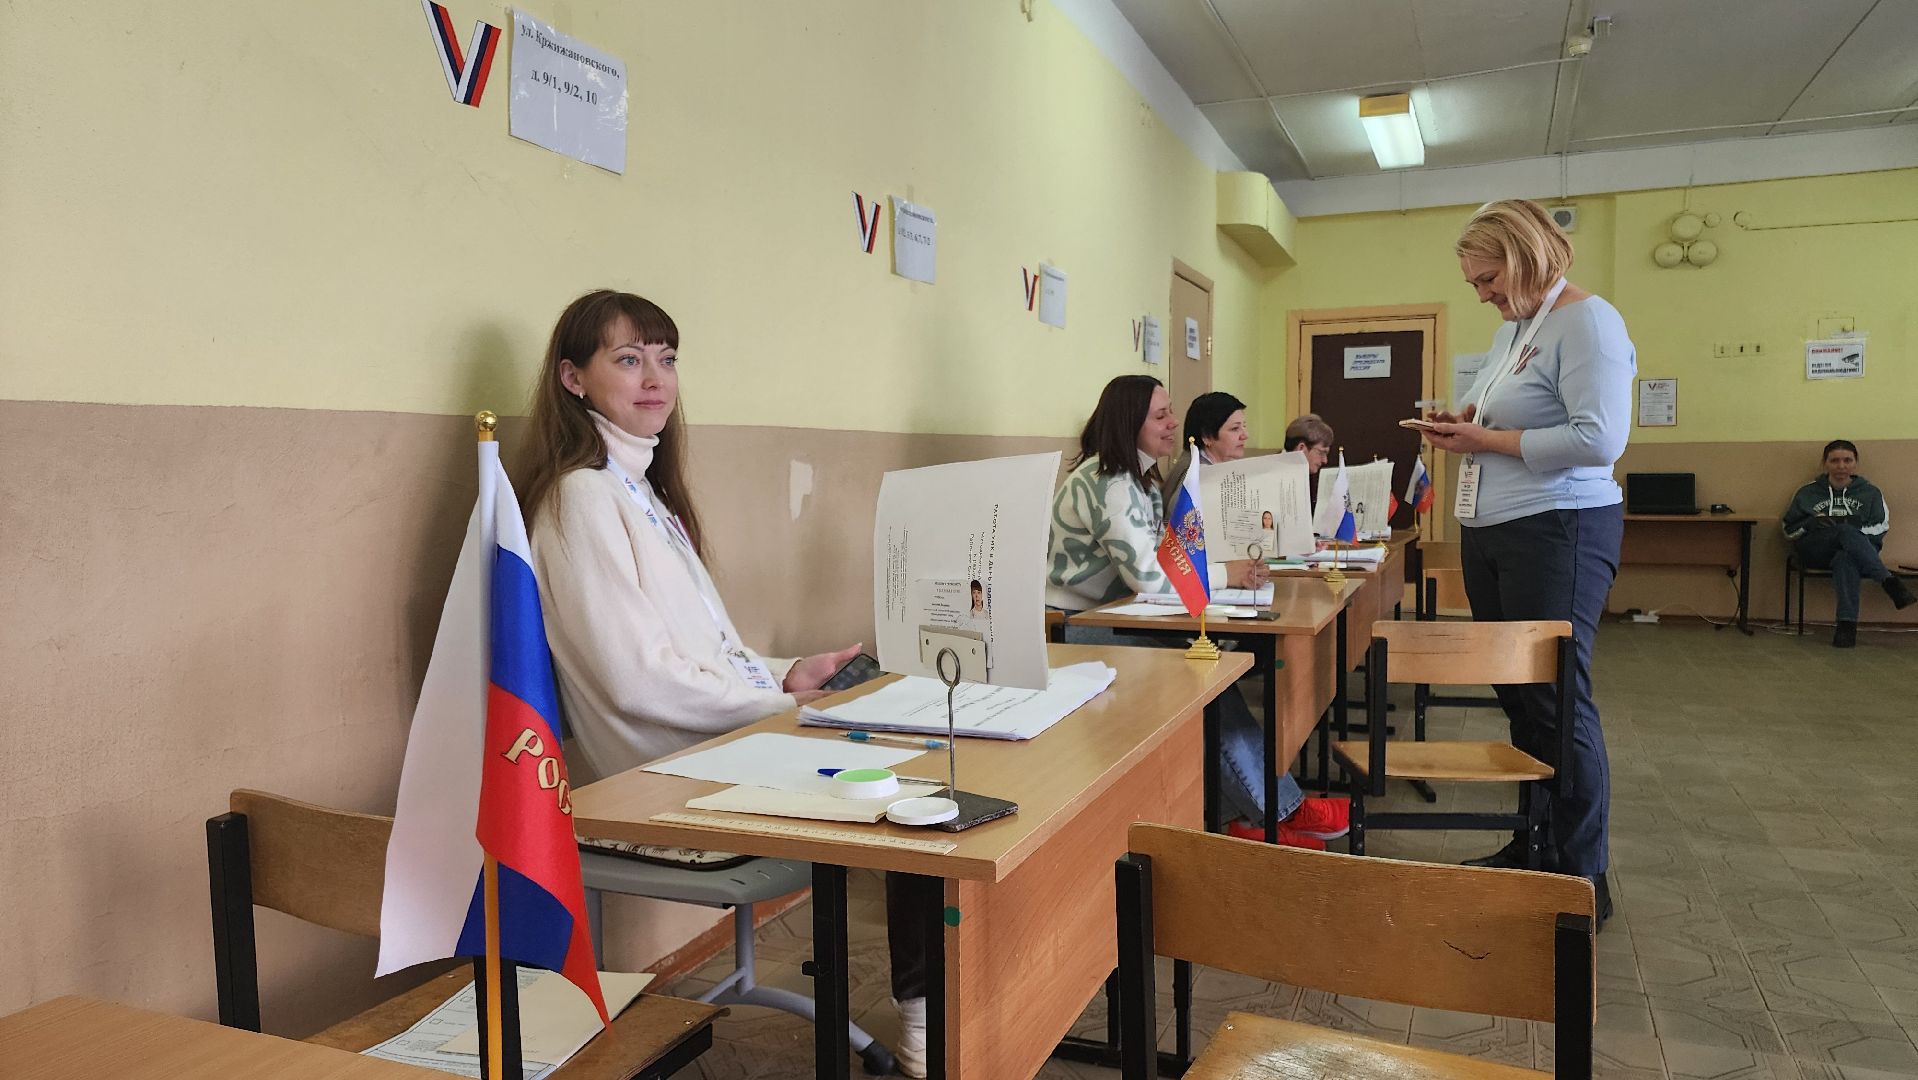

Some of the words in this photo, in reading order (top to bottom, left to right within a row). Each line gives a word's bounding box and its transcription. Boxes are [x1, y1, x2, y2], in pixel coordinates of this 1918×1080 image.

[520, 24, 534, 39] ул.
[535, 30, 620, 80] Кржижановского,
[530, 69, 541, 83] д.
[542, 71, 562, 94] 9/1,
[564, 81, 584, 103] 9/2,
[586, 90, 598, 106] 10
